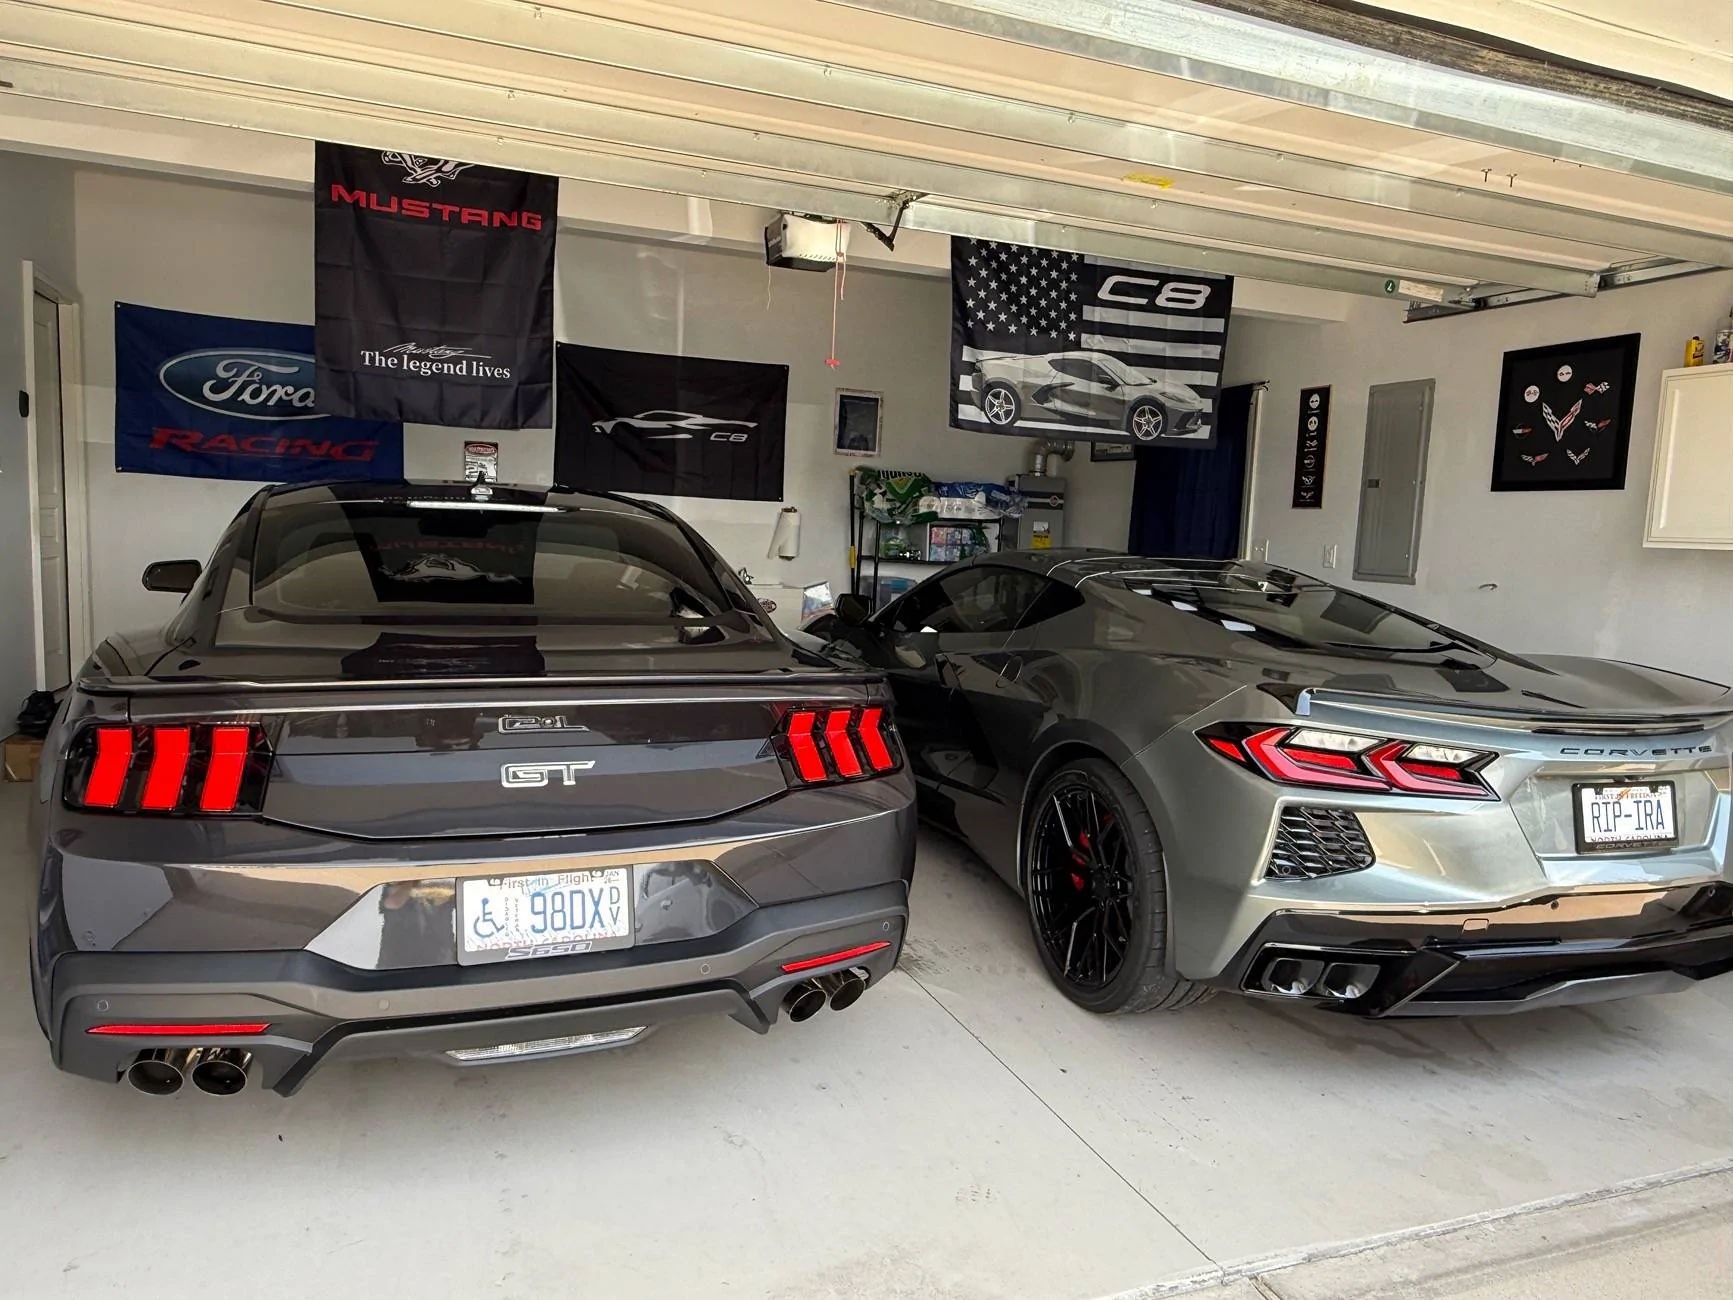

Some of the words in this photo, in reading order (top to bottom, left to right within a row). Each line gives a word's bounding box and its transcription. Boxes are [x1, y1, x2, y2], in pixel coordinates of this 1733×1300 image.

[331, 184, 542, 231] MUSTANG
[1097, 275, 1211, 310] C8
[361, 350, 398, 368] The
[402, 355, 467, 376] legend
[472, 361, 511, 379] lives
[149, 427, 379, 461] RACING
[710, 432, 748, 442] C8
[1560, 745, 1712, 756] CORVETTE
[500, 760, 595, 788] GT
[1591, 799, 1665, 833] RIP-IRA
[531, 888, 605, 933] 98DX
[505, 941, 592, 959] S650
